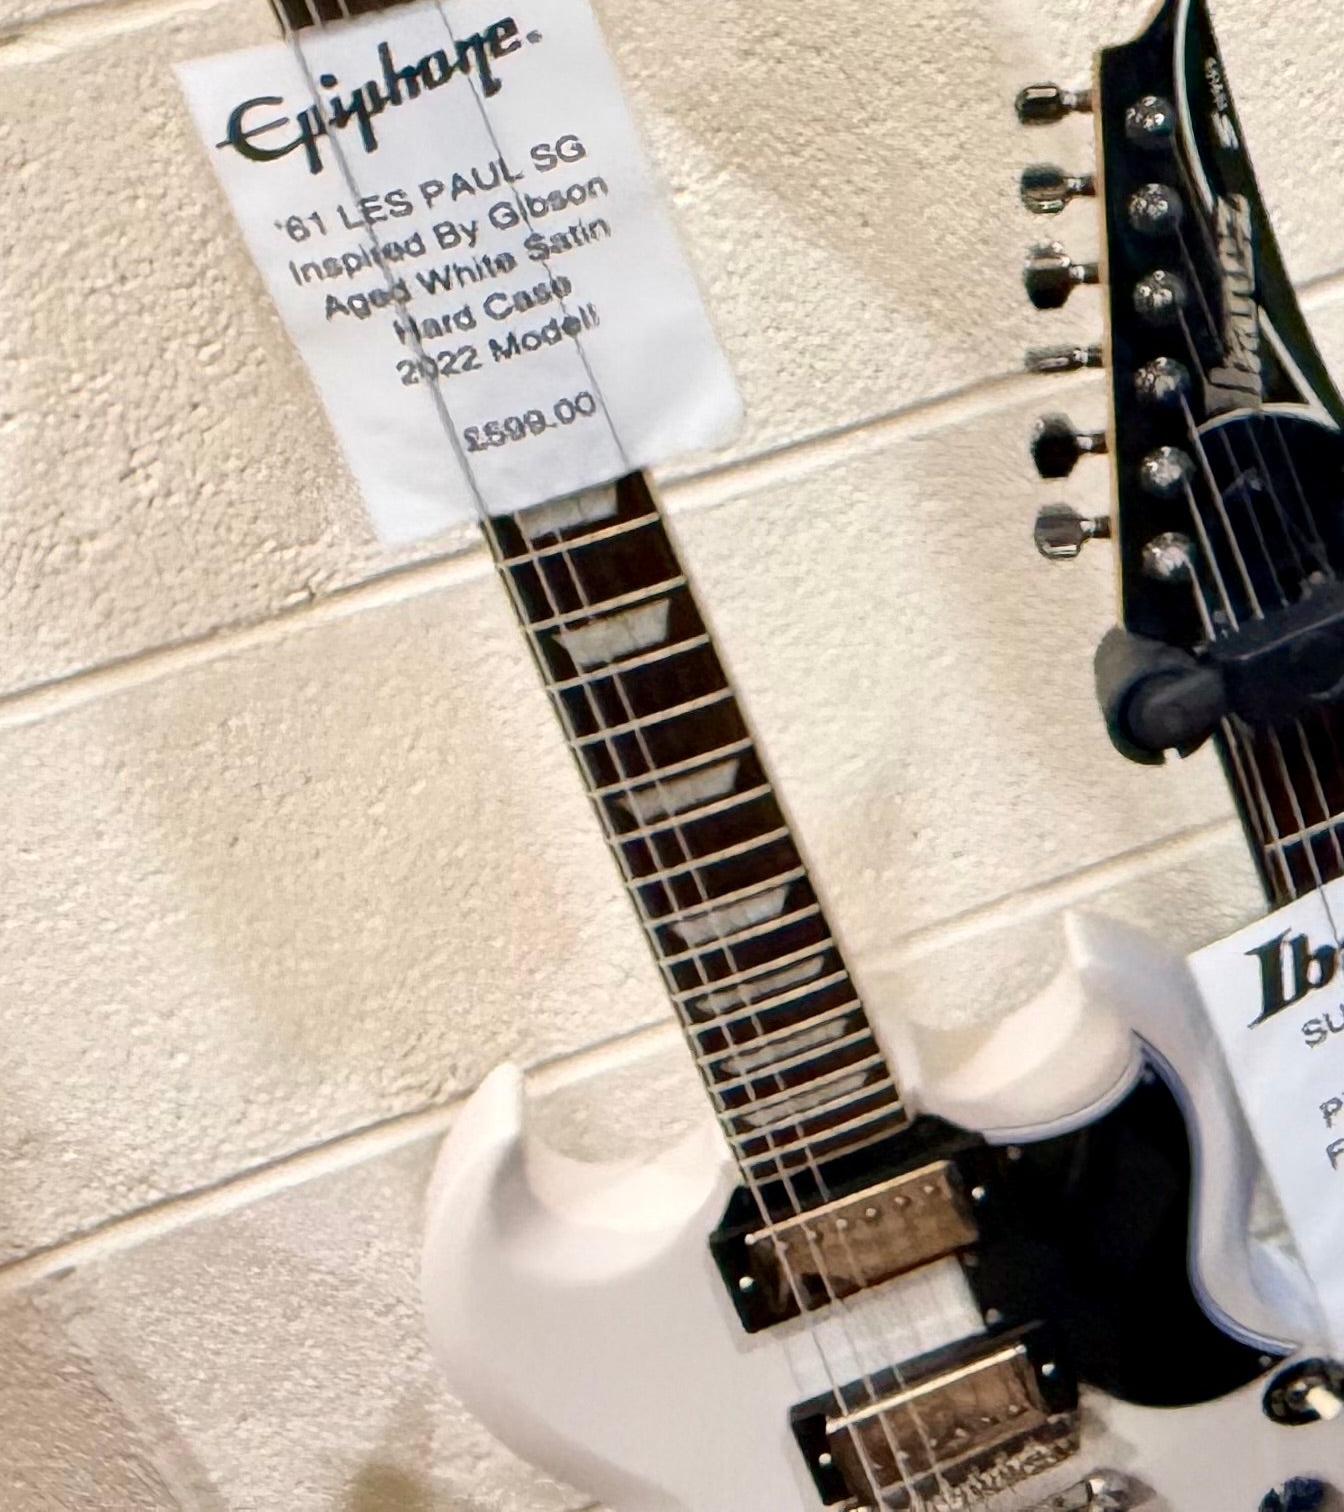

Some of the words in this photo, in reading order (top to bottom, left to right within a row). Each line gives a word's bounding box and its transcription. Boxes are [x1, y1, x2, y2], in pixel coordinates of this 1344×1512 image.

[289, 234, 426, 286] Inspired
[434, 215, 480, 251] By
[489, 176, 610, 230] Gibson
[337, 191, 413, 232] LES
[424, 157, 524, 209] PAUL
[531, 135, 587, 174] SG
[324, 278, 412, 319] Aged
[417, 250, 517, 299] White
[523, 215, 613, 262] Satin
[393, 306, 477, 345] Hard
[483, 273, 573, 321] Case
[396, 348, 483, 385] 2022
